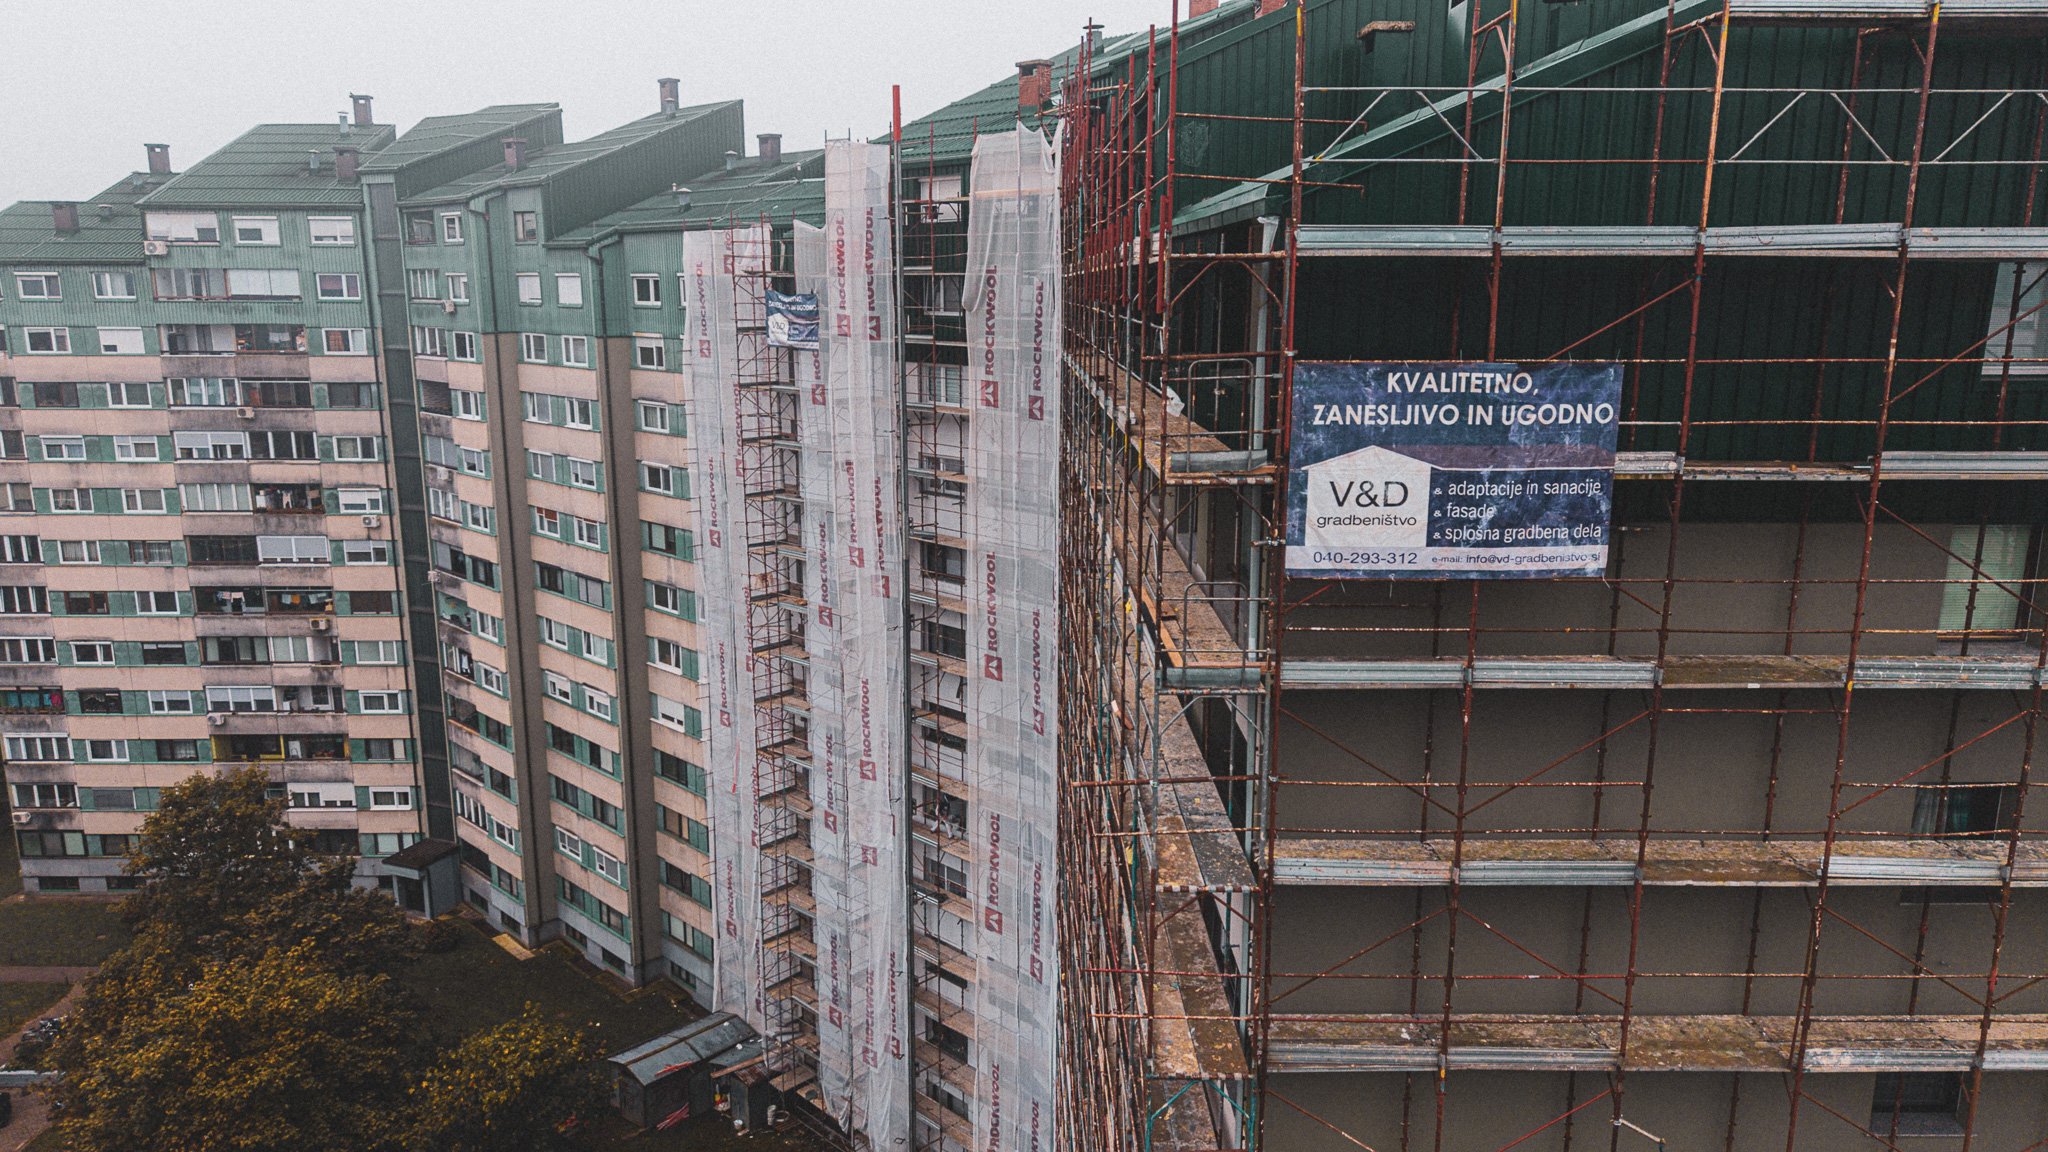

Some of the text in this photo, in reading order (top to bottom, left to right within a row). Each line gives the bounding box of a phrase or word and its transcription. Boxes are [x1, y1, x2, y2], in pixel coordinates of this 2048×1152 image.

[696, 261, 708, 337] ROCKWOOL
[836, 216, 847, 311] ROCKWOOL
[984, 265, 998, 376] ROCKWOOL
[1032, 281, 1044, 391] ROCKWOOL
[1312, 403, 1614, 426] ZANESLJIVO IN UGODNO
[1387, 371, 1539, 396] KVALITETNO,
[709, 457, 718, 528] ROCKWOOL
[845, 459, 858, 544] ROCKWOOL
[1316, 514, 1418, 529] gradbeništvo
[1329, 480, 1409, 508] V&D
[1447, 503, 1496, 518] fasade
[1448, 480, 1523, 499] adaptacije
[1526, 480, 1539, 495] in
[1543, 479, 1602, 497] sanacije
[819, 522, 829, 604] ROCKWOOL
[1313, 551, 1418, 565] 040-293-312
[1431, 556, 1463, 564] e-mail:
[1445, 525, 1500, 543] splošna
[1503, 524, 1569, 543] gradbena
[1573, 523, 1602, 538] dela
[986, 551, 998, 652] ROCKWOOL
[719, 641, 728, 709] ROCKWOOL
[1032, 608, 1041, 707] ROCKWOOL
[860, 678, 872, 758] ROCKWOOL
[826, 733, 834, 811] ROCKWOOL
[727, 859, 736, 921] ROCKWOOL
[989, 812, 1000, 907] ROCKWOOL
[1033, 861, 1042, 956] ROCKWOOL
[830, 934, 839, 1007] ROCKWOOL
[866, 969, 875, 1046] ROCKWOOL
[990, 1061, 999, 1149] ROCKWOOL
[1031, 1098, 1039, 1152] KWOOL
